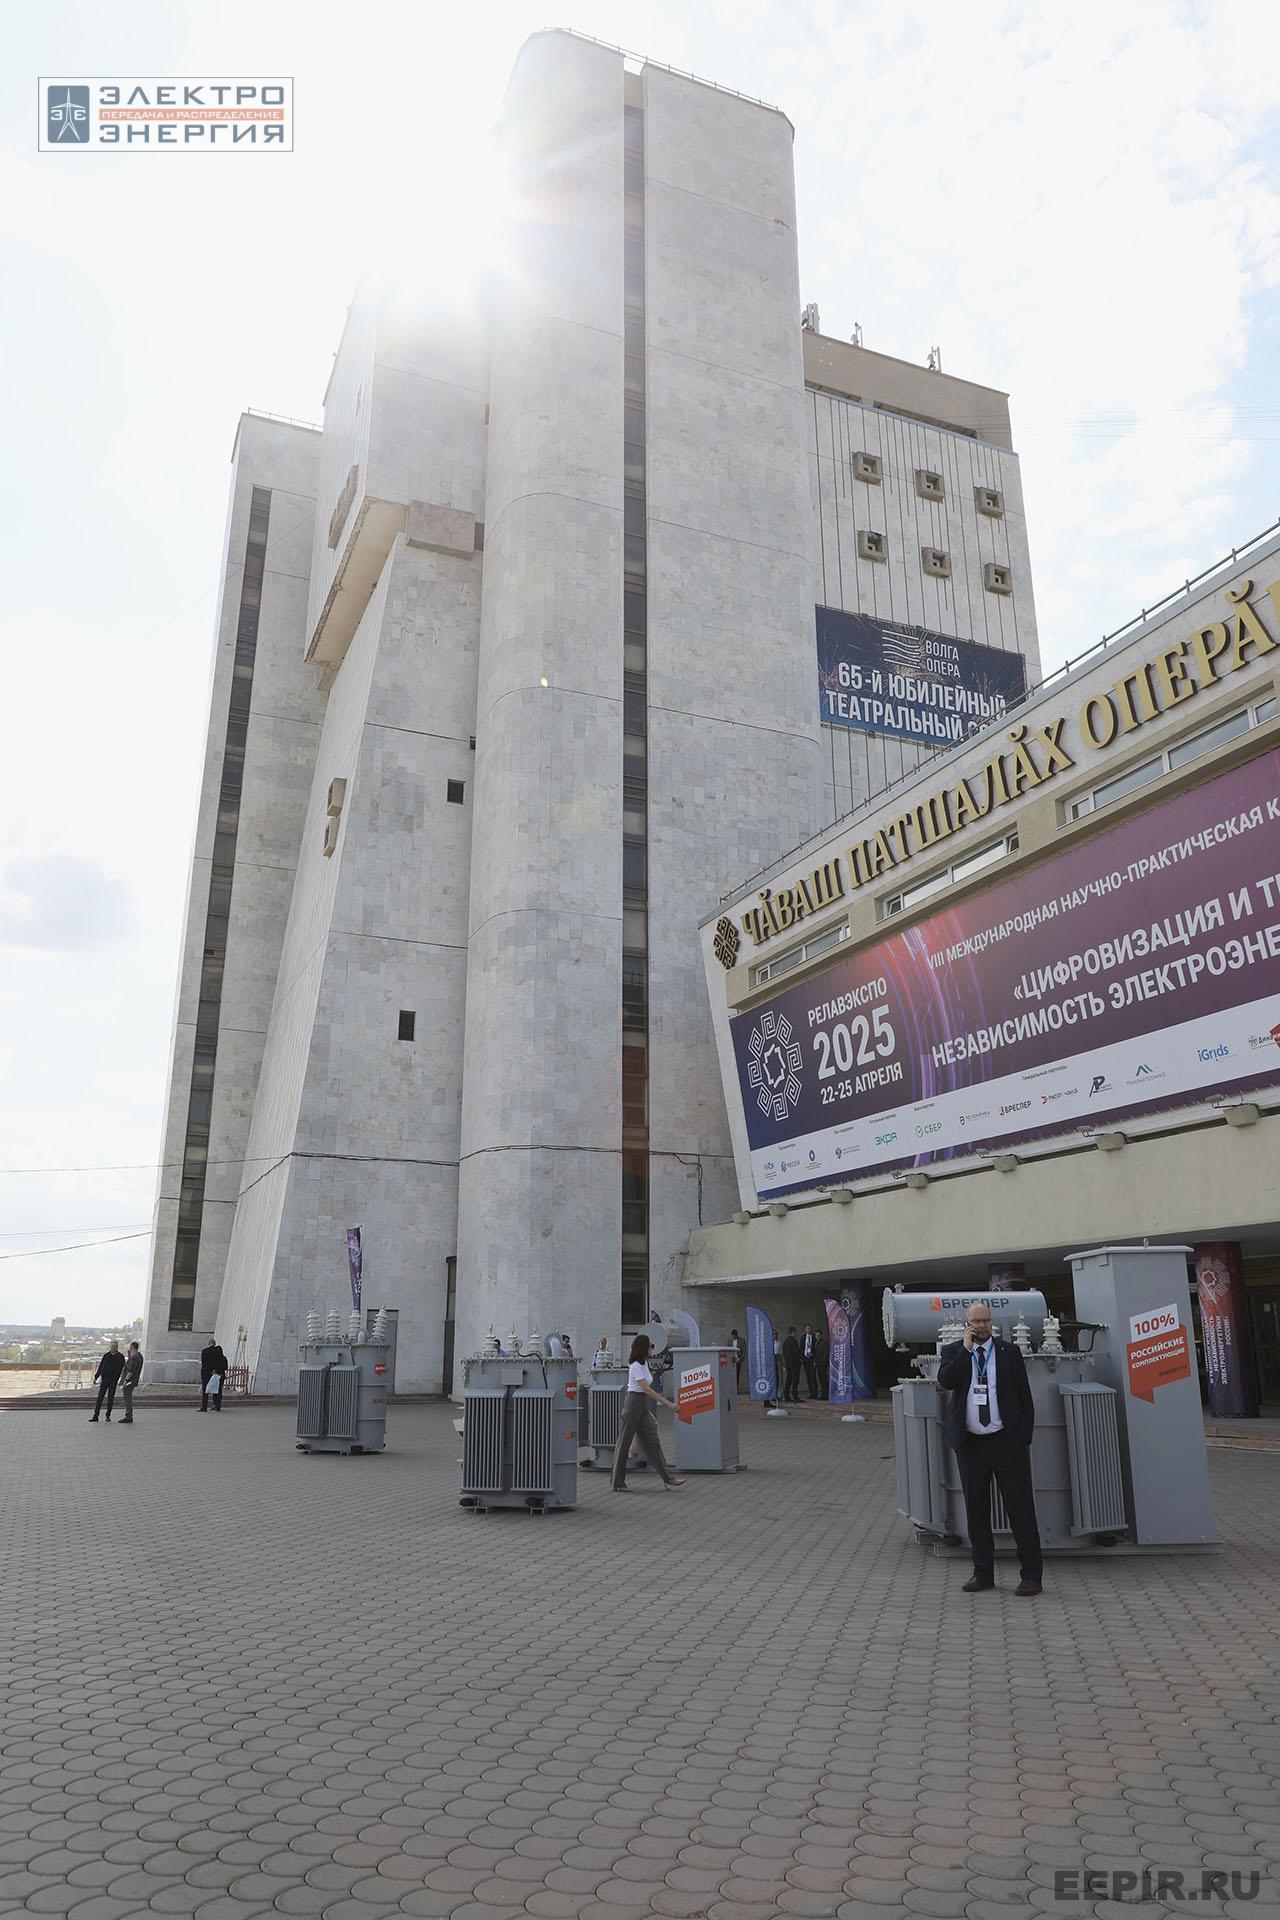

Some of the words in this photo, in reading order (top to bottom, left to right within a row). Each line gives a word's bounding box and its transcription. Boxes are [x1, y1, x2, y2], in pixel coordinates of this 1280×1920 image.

[925, 640, 960, 661] ВОЛГА
[926, 658, 961, 678] ОПЕРА
[825, 689, 964, 741] ТЕАТРАЛЬНЫЙ
[946, 900, 1060, 963] МЕЖДУНАРОДНАЯ
[1060, 806, 1264, 912] НАУЧНО-ПРАКТИЧЕСКАЯ
[1228, 887, 1254, 921] И
[807, 977, 888, 1027] РЕЛАВЭКСПО
[812, 1004, 897, 1080] 2025
[931, 990, 1106, 1070] НЕЗАВИСИМОСТЬ
[820, 1079, 854, 1105] 22-25
[855, 1061, 904, 1095] АПРЕЛЯ
[923, 1122, 943, 1135] СБЕР
[1134, 1313, 1176, 1336] 100%
[1130, 1336, 1185, 1360] РОССИЙСКИЕ
[683, 1369, 709, 1383] 100%
